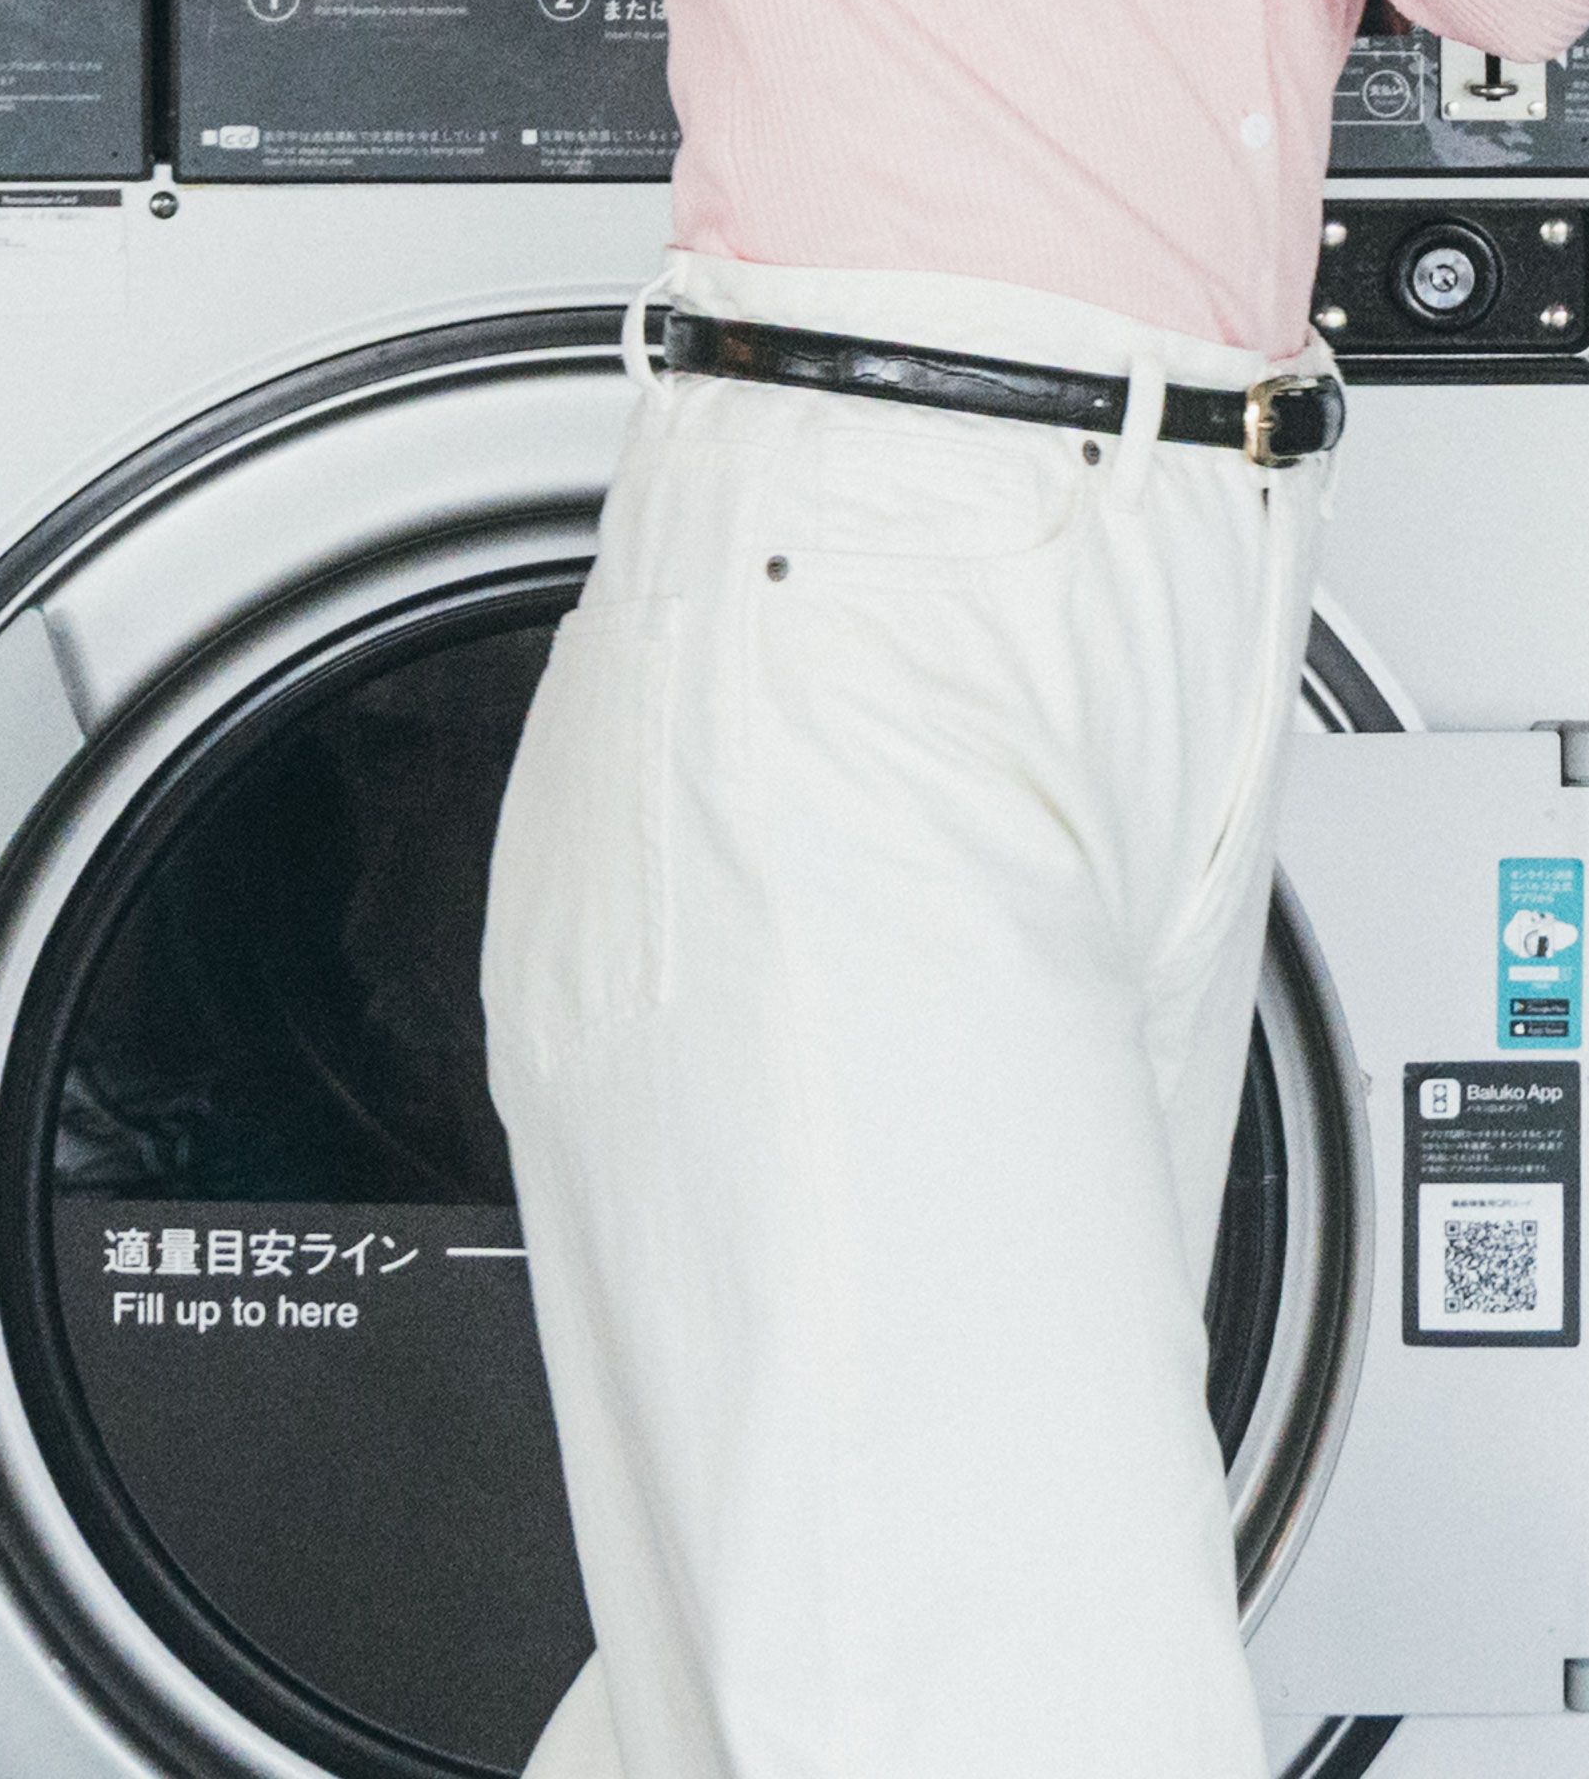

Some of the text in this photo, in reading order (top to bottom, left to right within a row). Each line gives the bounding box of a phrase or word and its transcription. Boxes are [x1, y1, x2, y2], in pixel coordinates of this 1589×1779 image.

[1467, 1083, 1564, 1103] Baluko App
[104, 1228, 418, 1276] 適量目安ライン
[114, 1292, 358, 1333] Fill up to here
